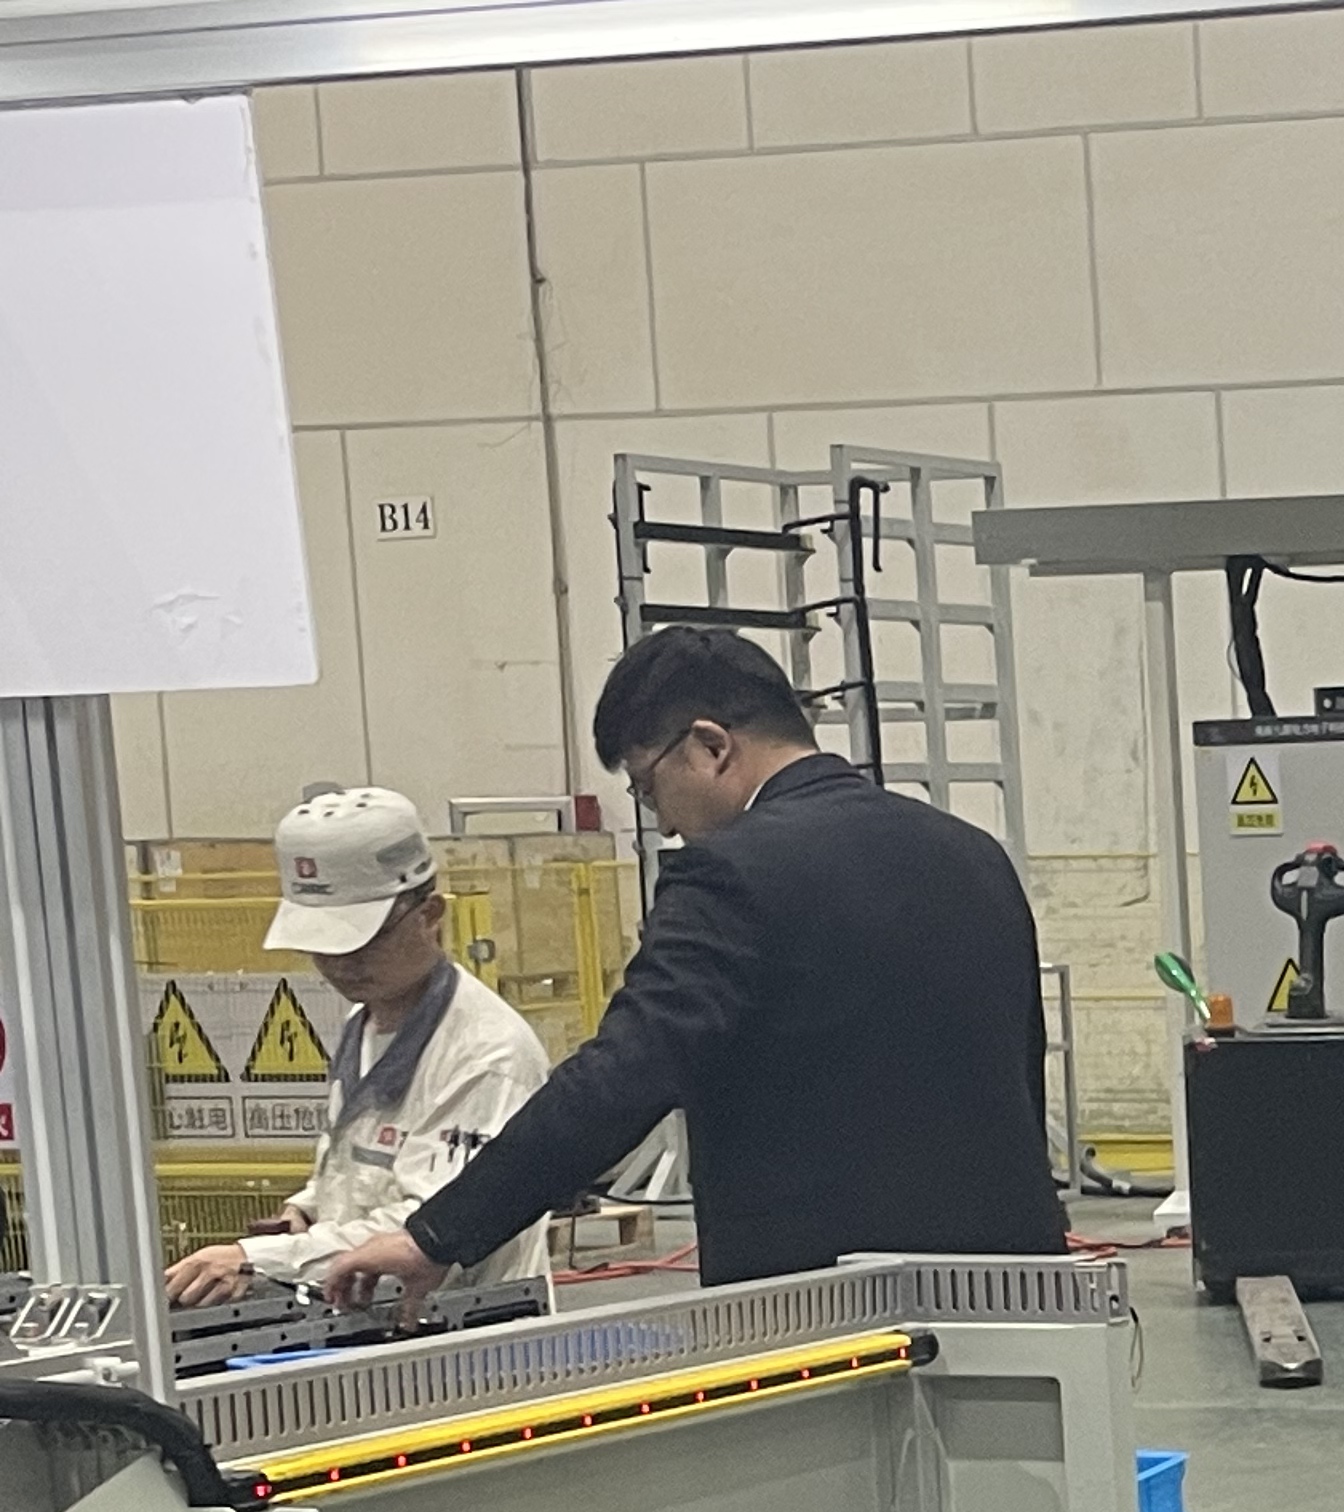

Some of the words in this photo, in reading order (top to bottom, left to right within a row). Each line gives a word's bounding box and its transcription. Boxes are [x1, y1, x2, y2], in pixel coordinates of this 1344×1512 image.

[378, 501, 430, 532] B14
[167, 1104, 229, 1132] 心触电
